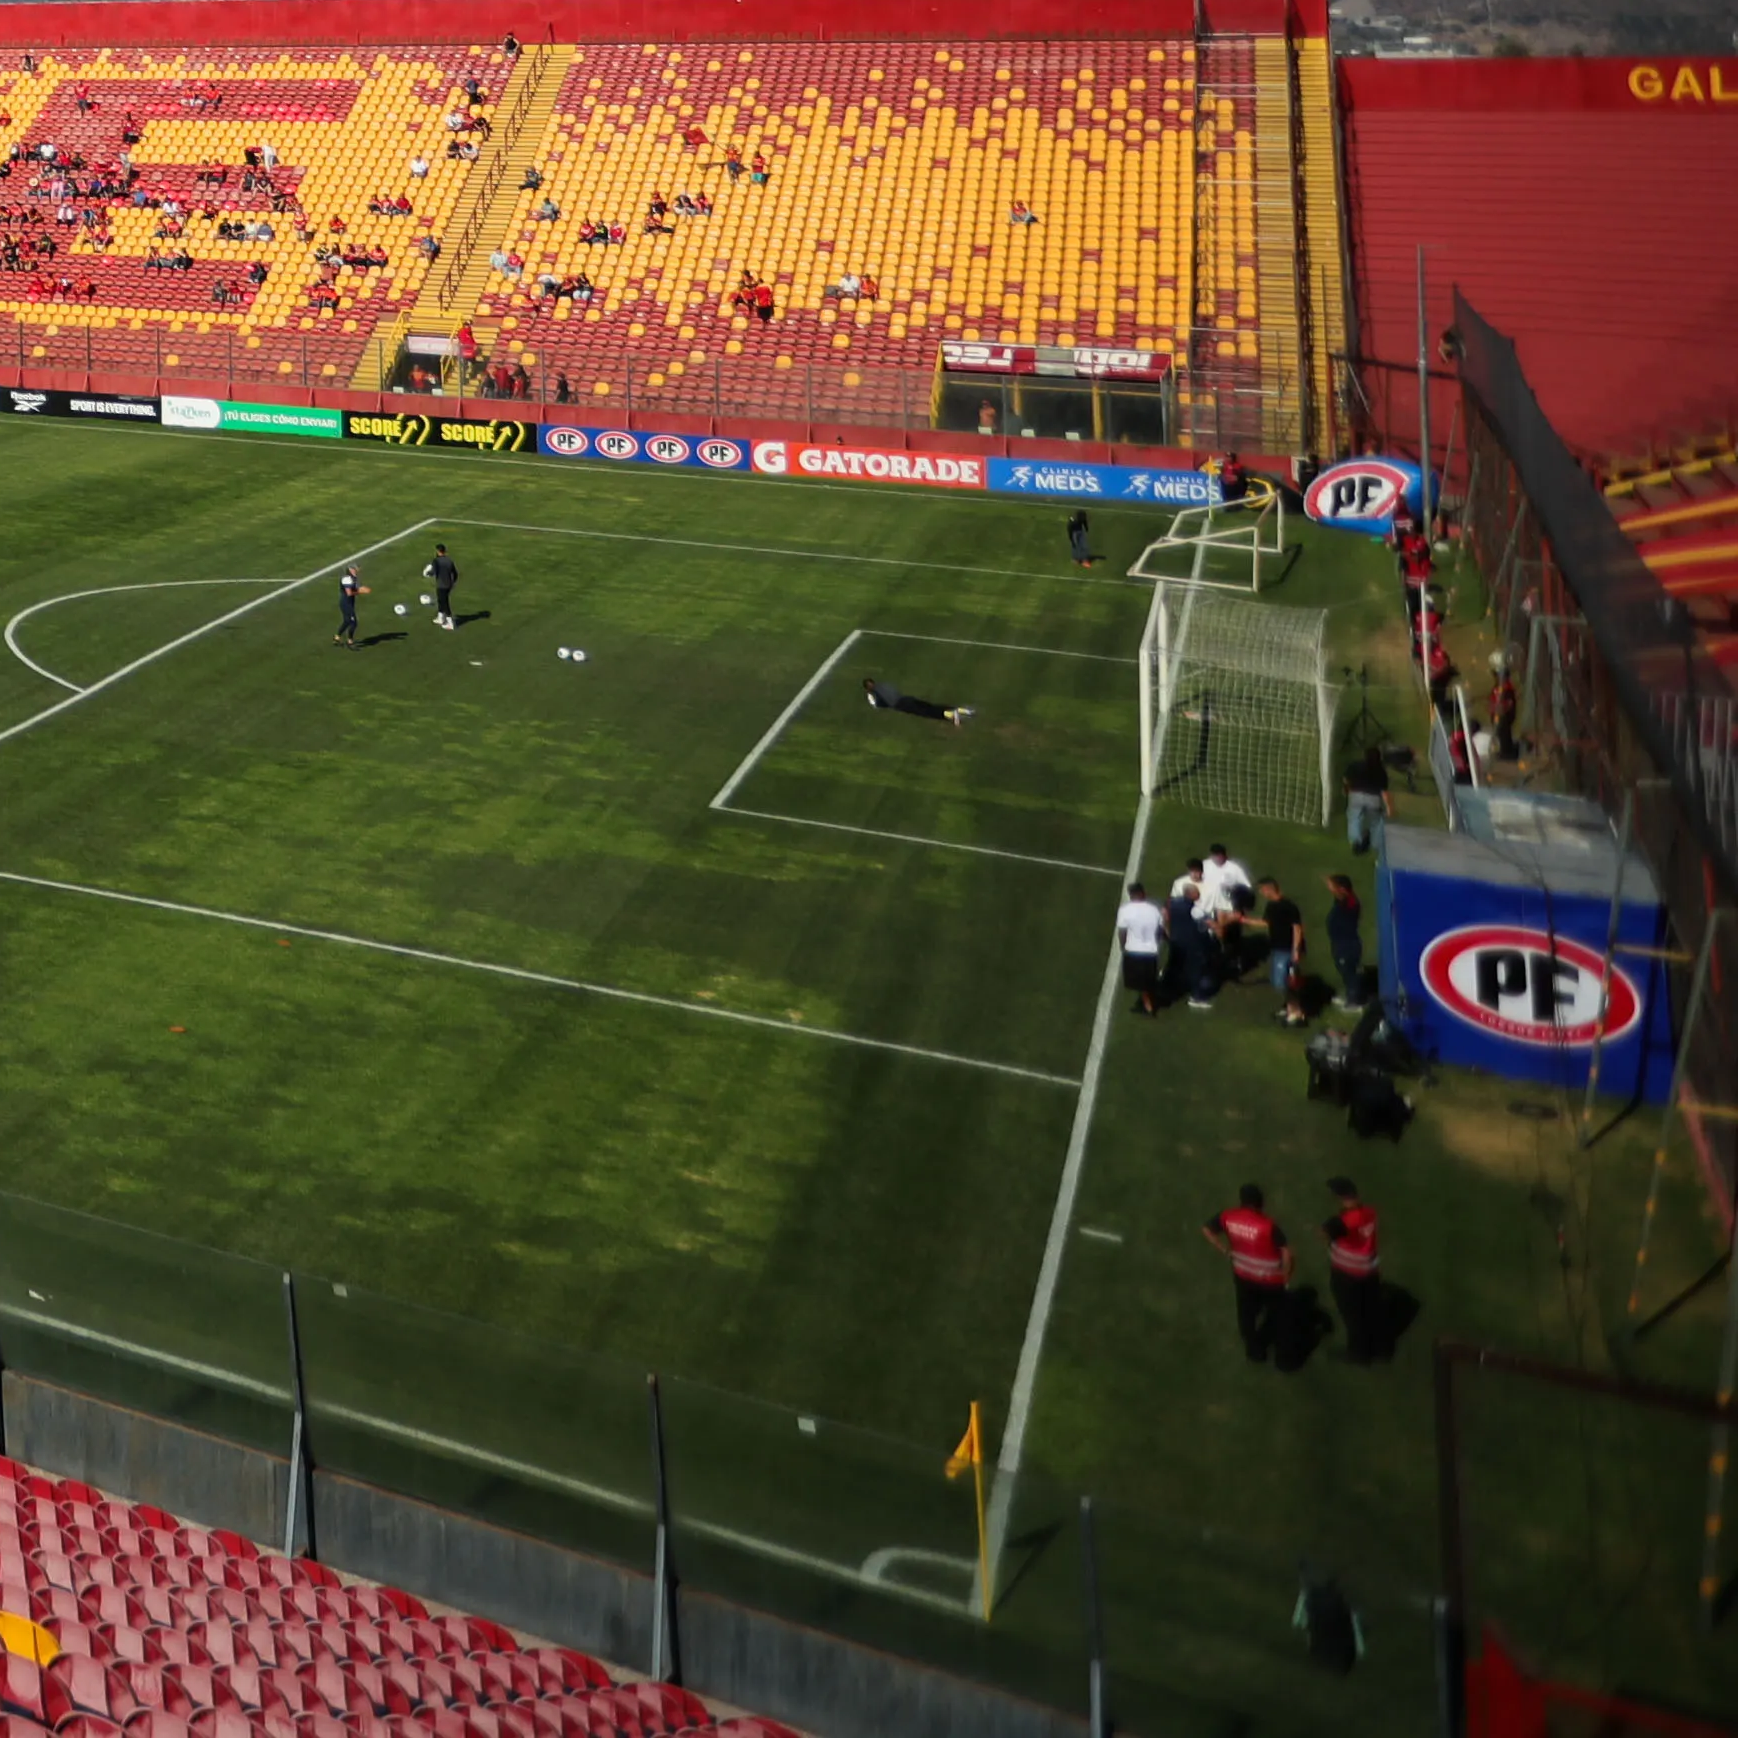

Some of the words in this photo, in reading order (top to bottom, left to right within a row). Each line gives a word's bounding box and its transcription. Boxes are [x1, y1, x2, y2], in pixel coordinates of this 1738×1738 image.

[1627, 65, 1738, 101] GAL
[10, 390, 47, 402] Reebok
[70, 398, 96, 412] SPORT
[96, 401, 105, 413] IS
[105, 402, 157, 417] EVERYTHING.
[224, 411, 239, 424] ¡TÚ
[240, 414, 271, 425] ELIGES
[272, 414, 299, 427] CÓMO
[300, 417, 338, 430] ENVIAR!
[349, 416, 402, 437] SCORE
[440, 423, 495, 444] SCORE
[557, 432, 577, 449] PF
[606, 436, 627, 453] PF
[657, 440, 677, 457] PF
[708, 443, 729, 461] PF
[753, 442, 785, 473] G
[799, 448, 980, 484] GATORADE
[1035, 473, 1100, 493] MEDS
[1153, 481, 1222, 501] MEDS
[1329, 476, 1383, 516] PF
[1476, 949, 1580, 1022] PF
